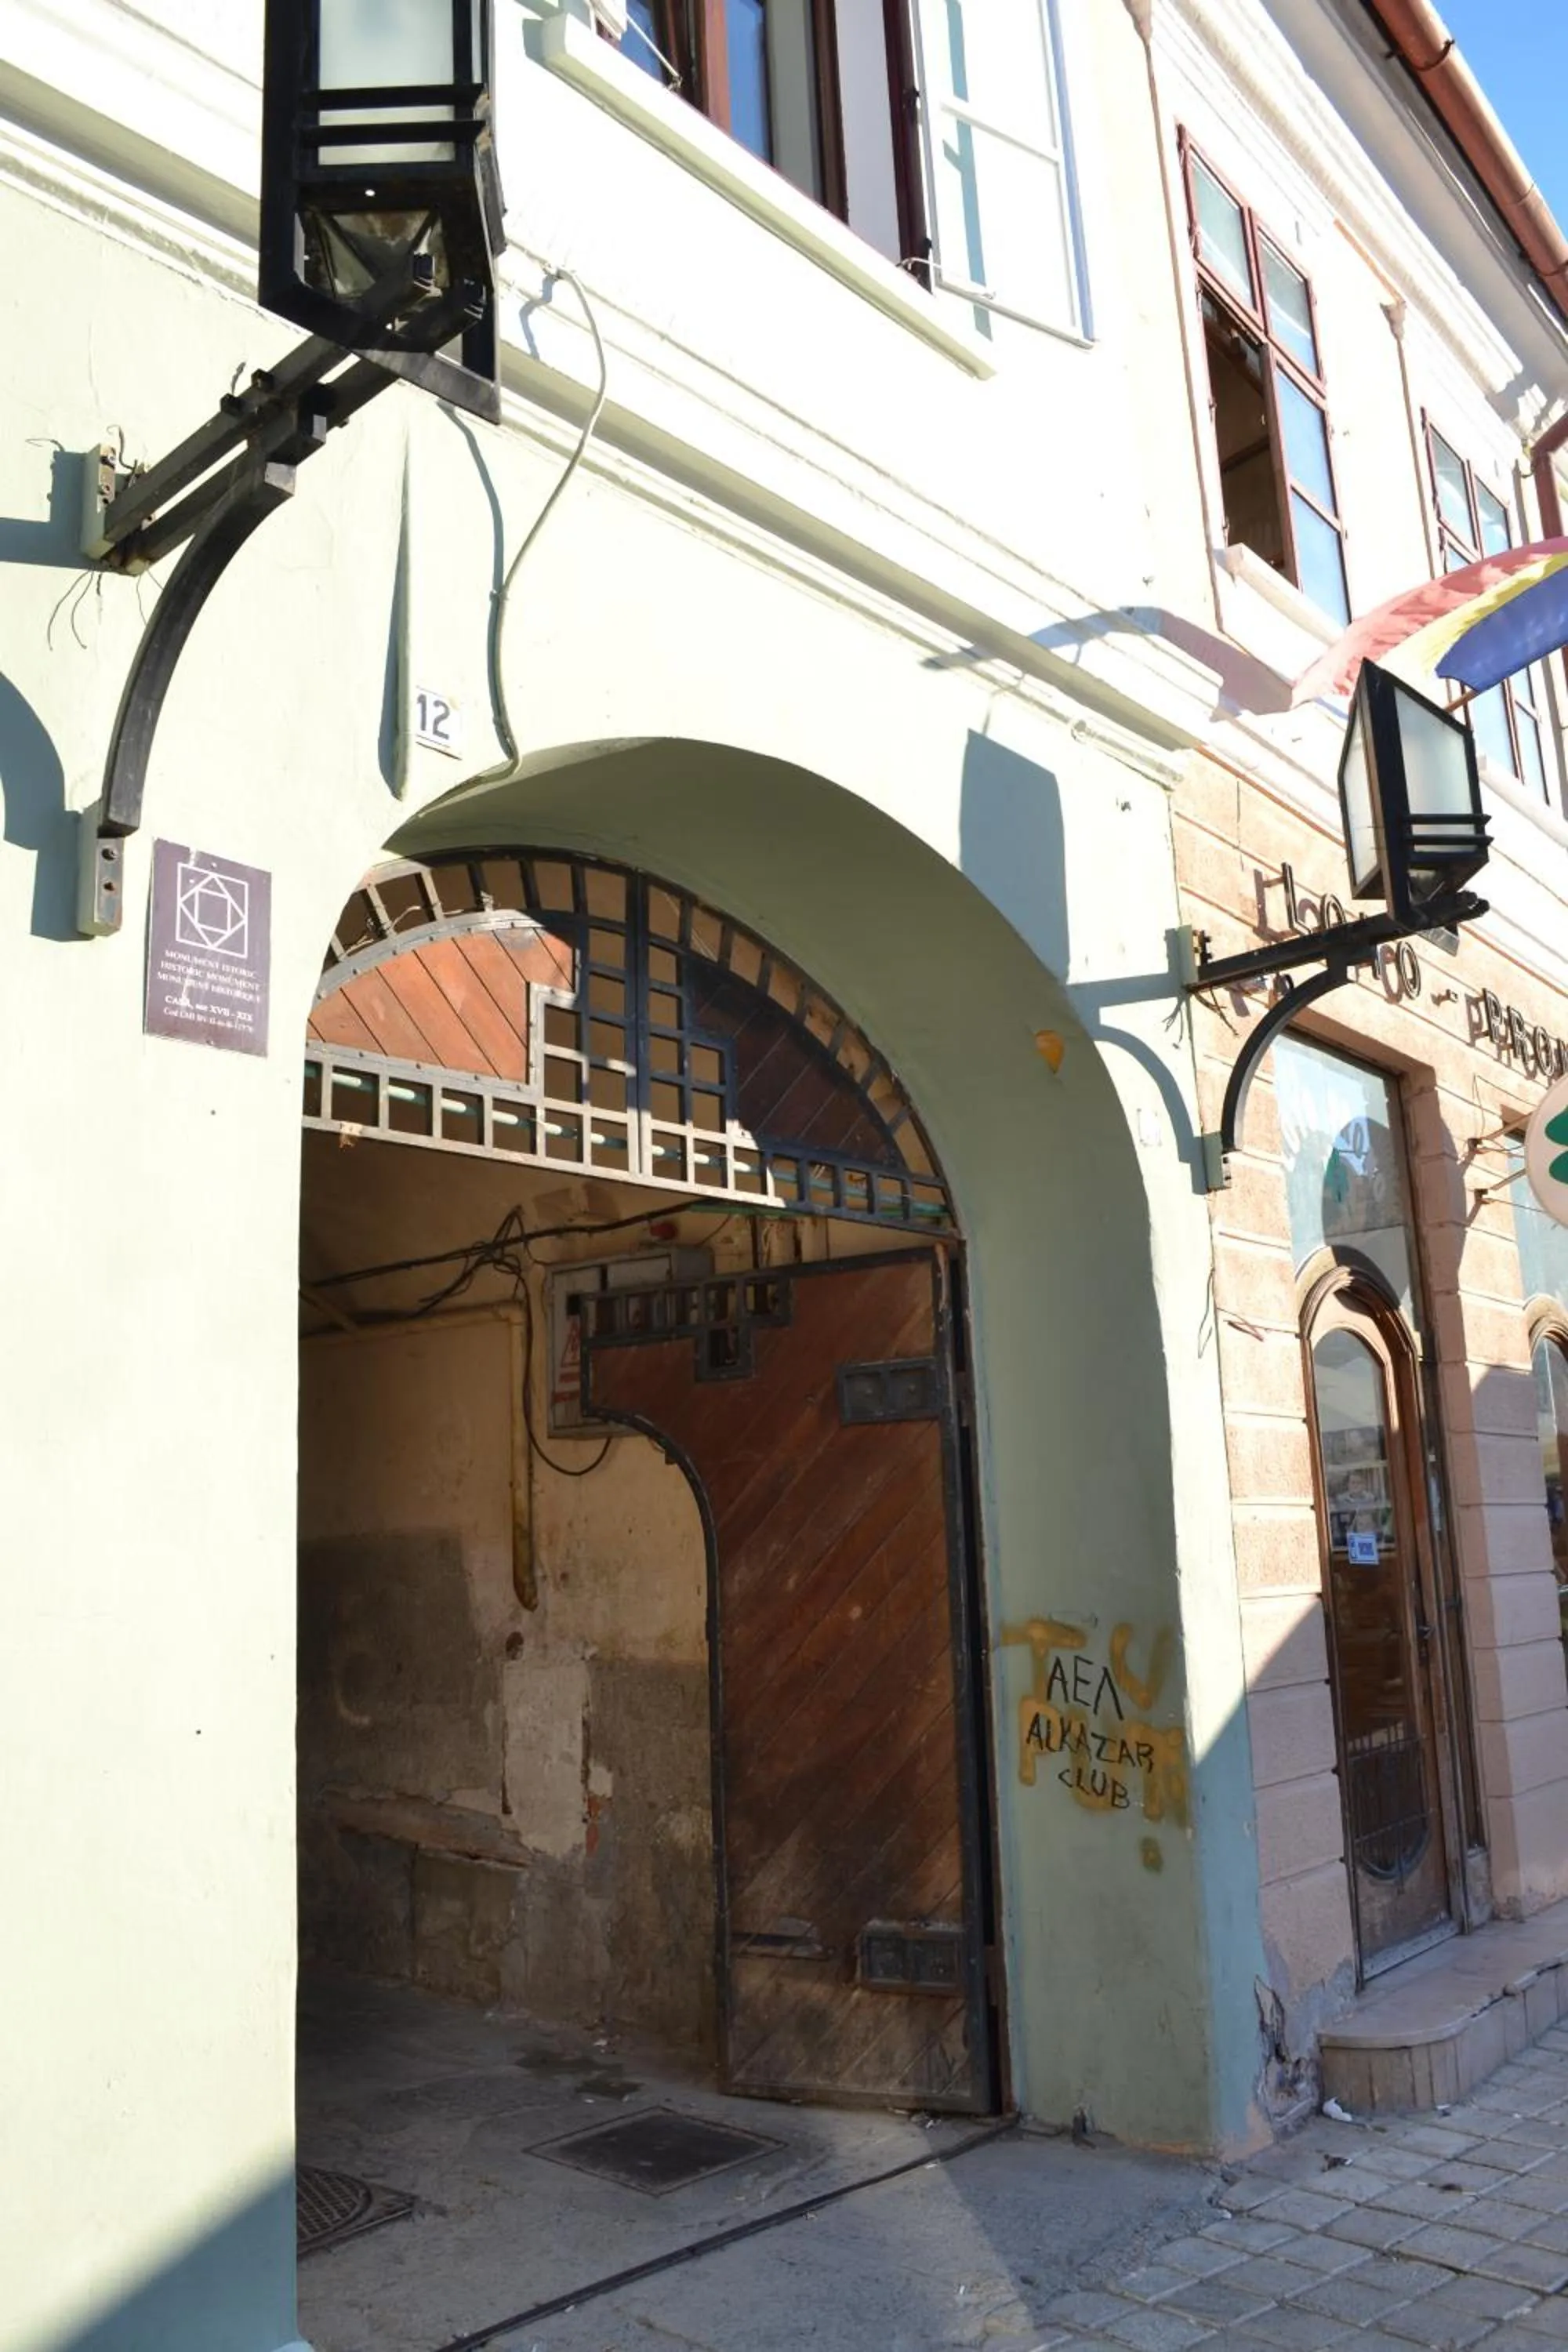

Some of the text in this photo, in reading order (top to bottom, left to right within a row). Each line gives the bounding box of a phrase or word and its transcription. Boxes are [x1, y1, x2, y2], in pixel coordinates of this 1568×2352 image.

[416, 693, 450, 741] 12
[165, 949, 219, 969] MONUMENT
[206, 971, 260, 991] MONUMENT
[1058, 1767, 1130, 1809] CLUB
